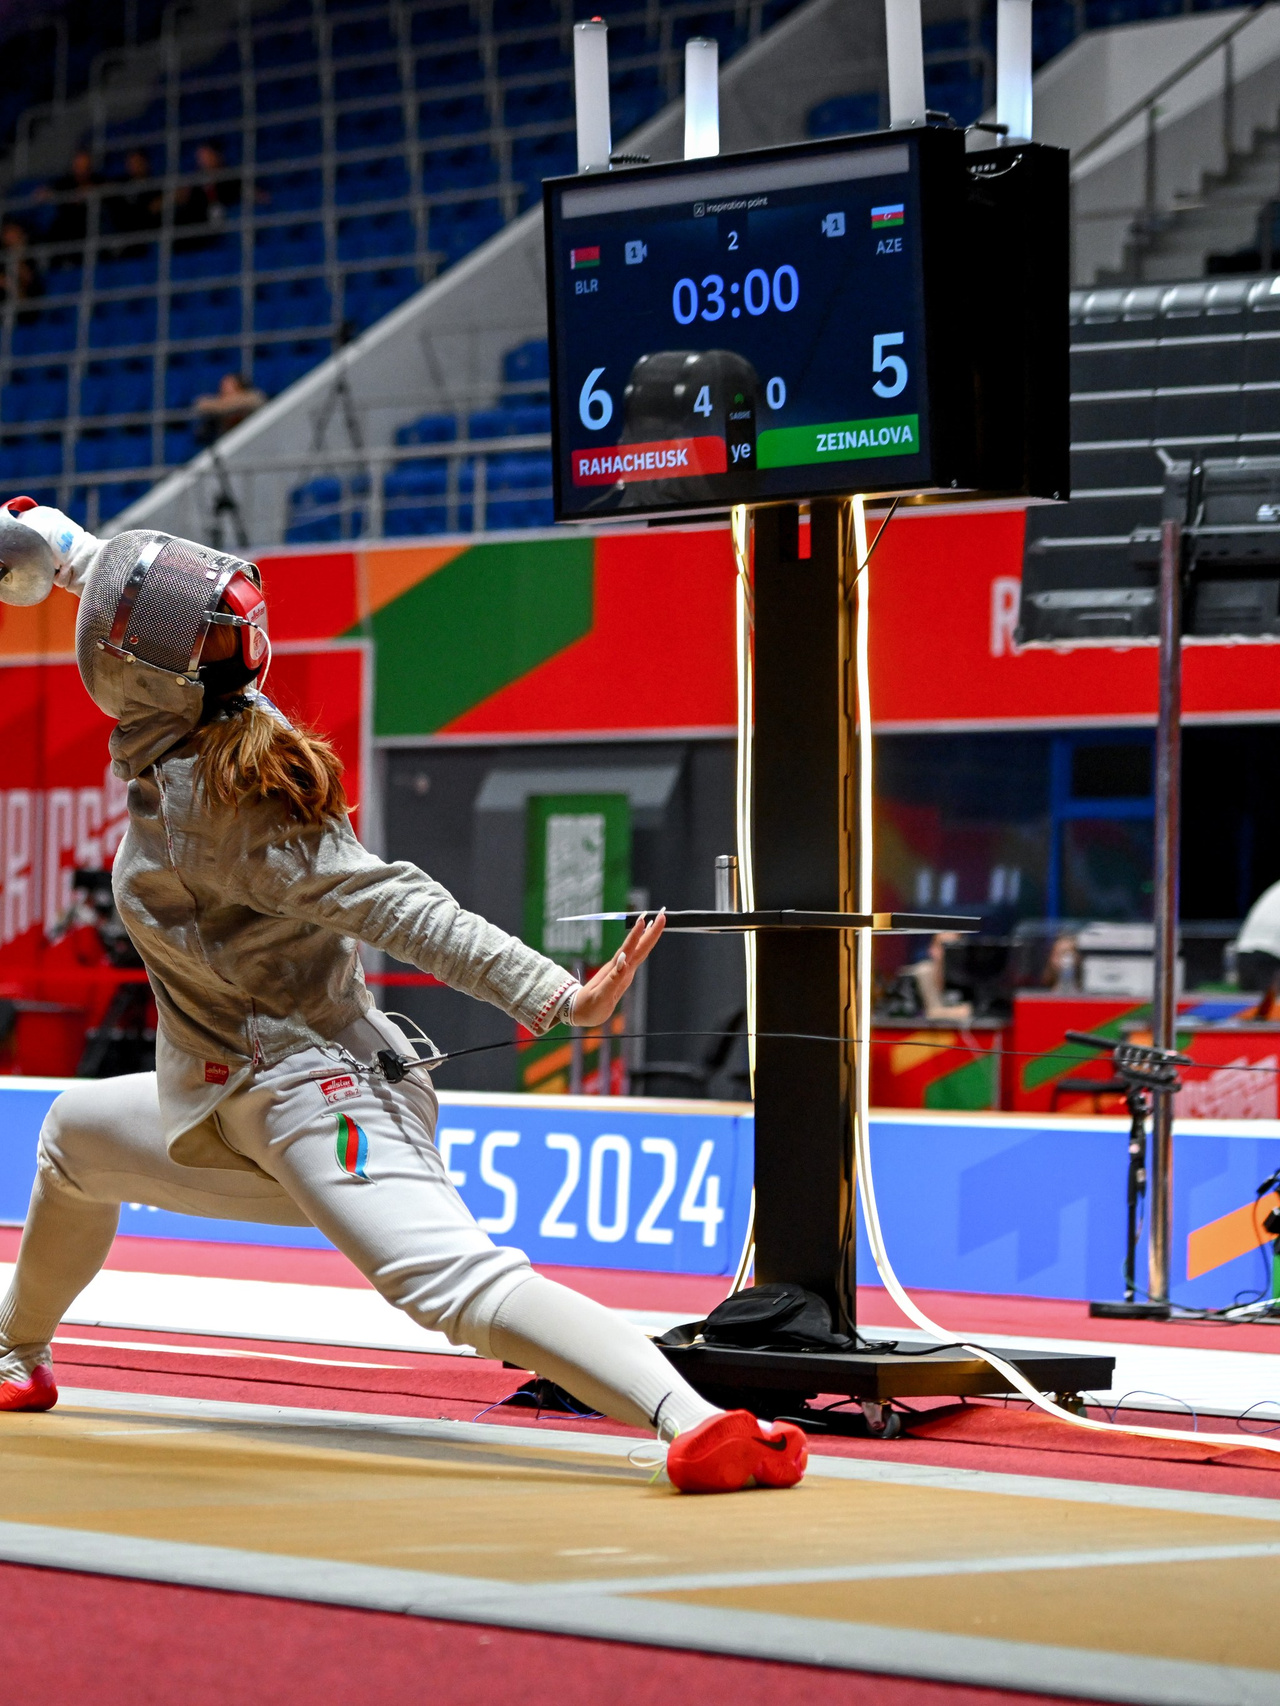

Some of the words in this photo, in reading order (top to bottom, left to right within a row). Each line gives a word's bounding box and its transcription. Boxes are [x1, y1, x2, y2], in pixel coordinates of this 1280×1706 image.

[747, 197, 768, 209] point
[727, 230, 739, 251] 2
[876, 237, 903, 255] AZE
[575, 278, 599, 295] BLR
[672, 264, 800, 325] 03:00
[871, 331, 910, 398] 5
[578, 367, 613, 431] 6
[693, 385, 713, 418] 4
[766, 376, 787, 410] 0
[731, 442, 751, 464] ye
[816, 425, 913, 453] ZEINALOVA
[578, 448, 689, 477] RAHACHEUSK
[539, 1132, 725, 1248] 2024
